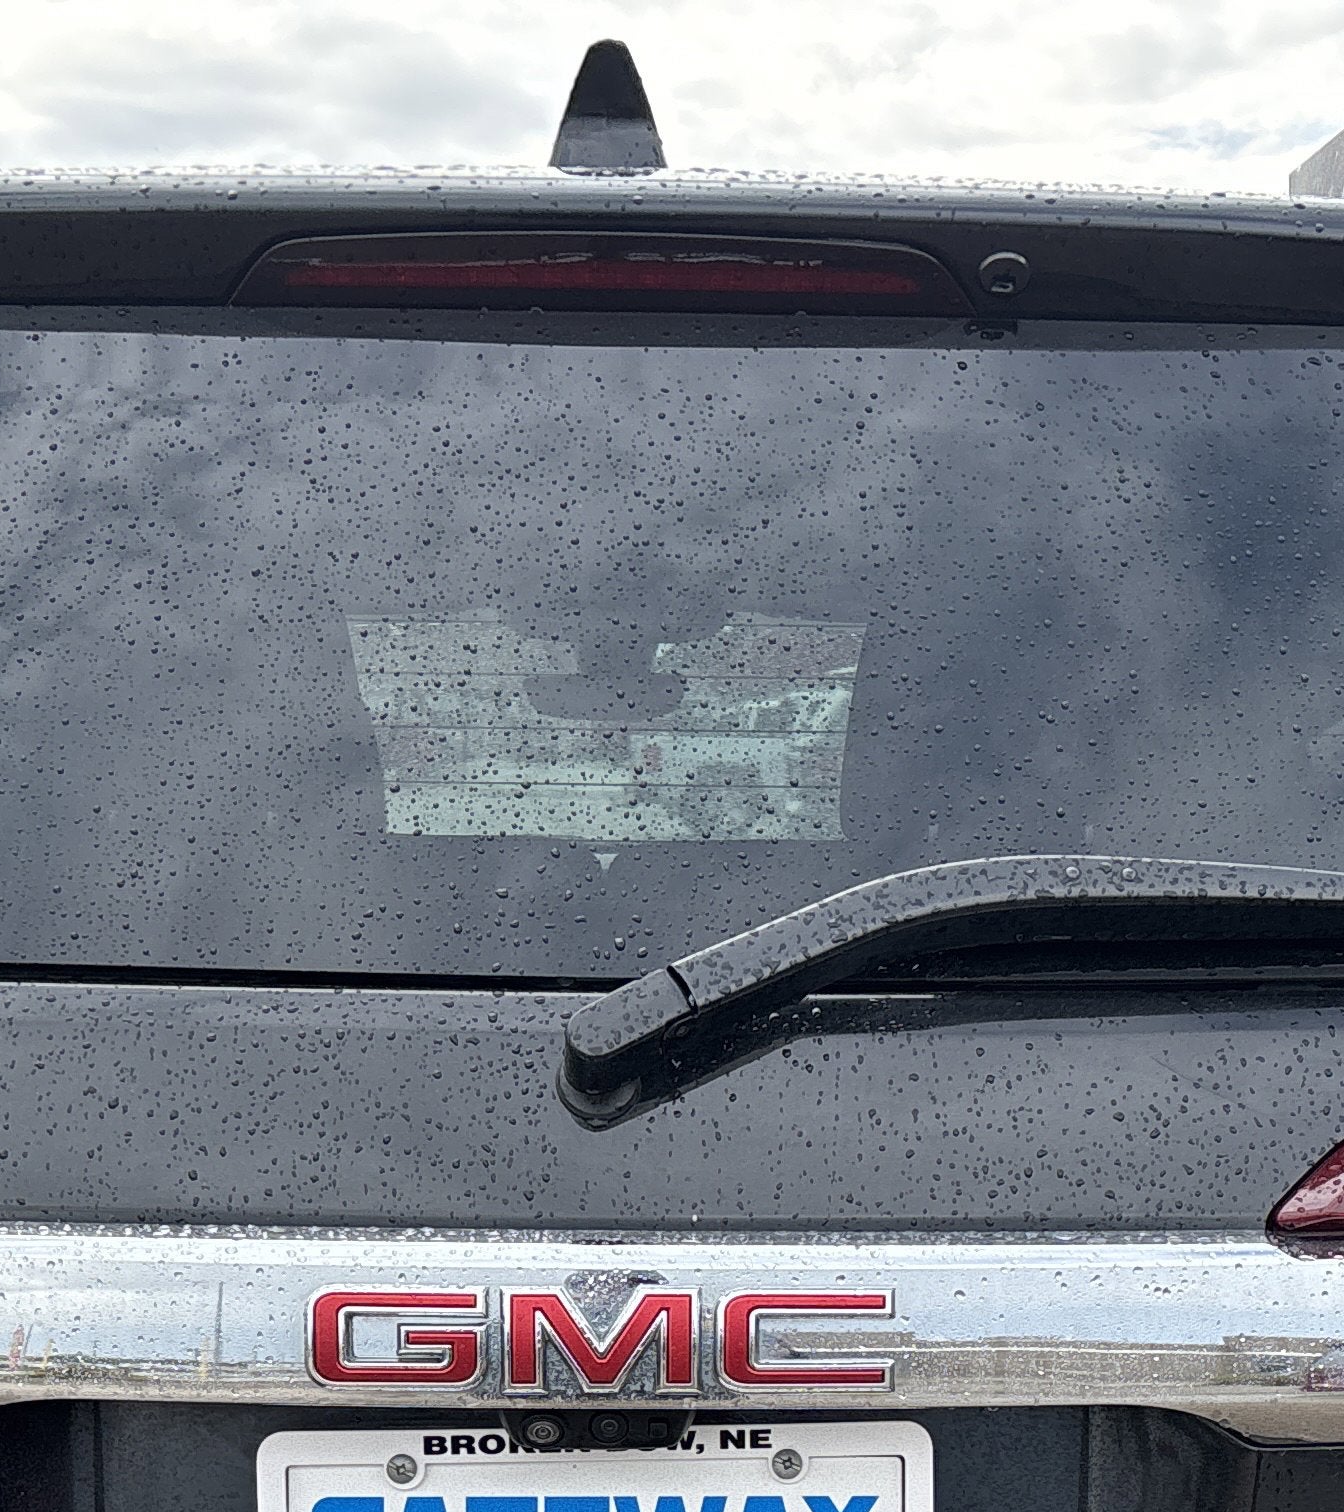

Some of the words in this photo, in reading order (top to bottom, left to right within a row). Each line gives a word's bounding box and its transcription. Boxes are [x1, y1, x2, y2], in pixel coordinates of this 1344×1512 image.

[307, 1285, 897, 1396] GMC
[422, 1434, 591, 1455] BRO
[719, 1428, 773, 1450] NE
